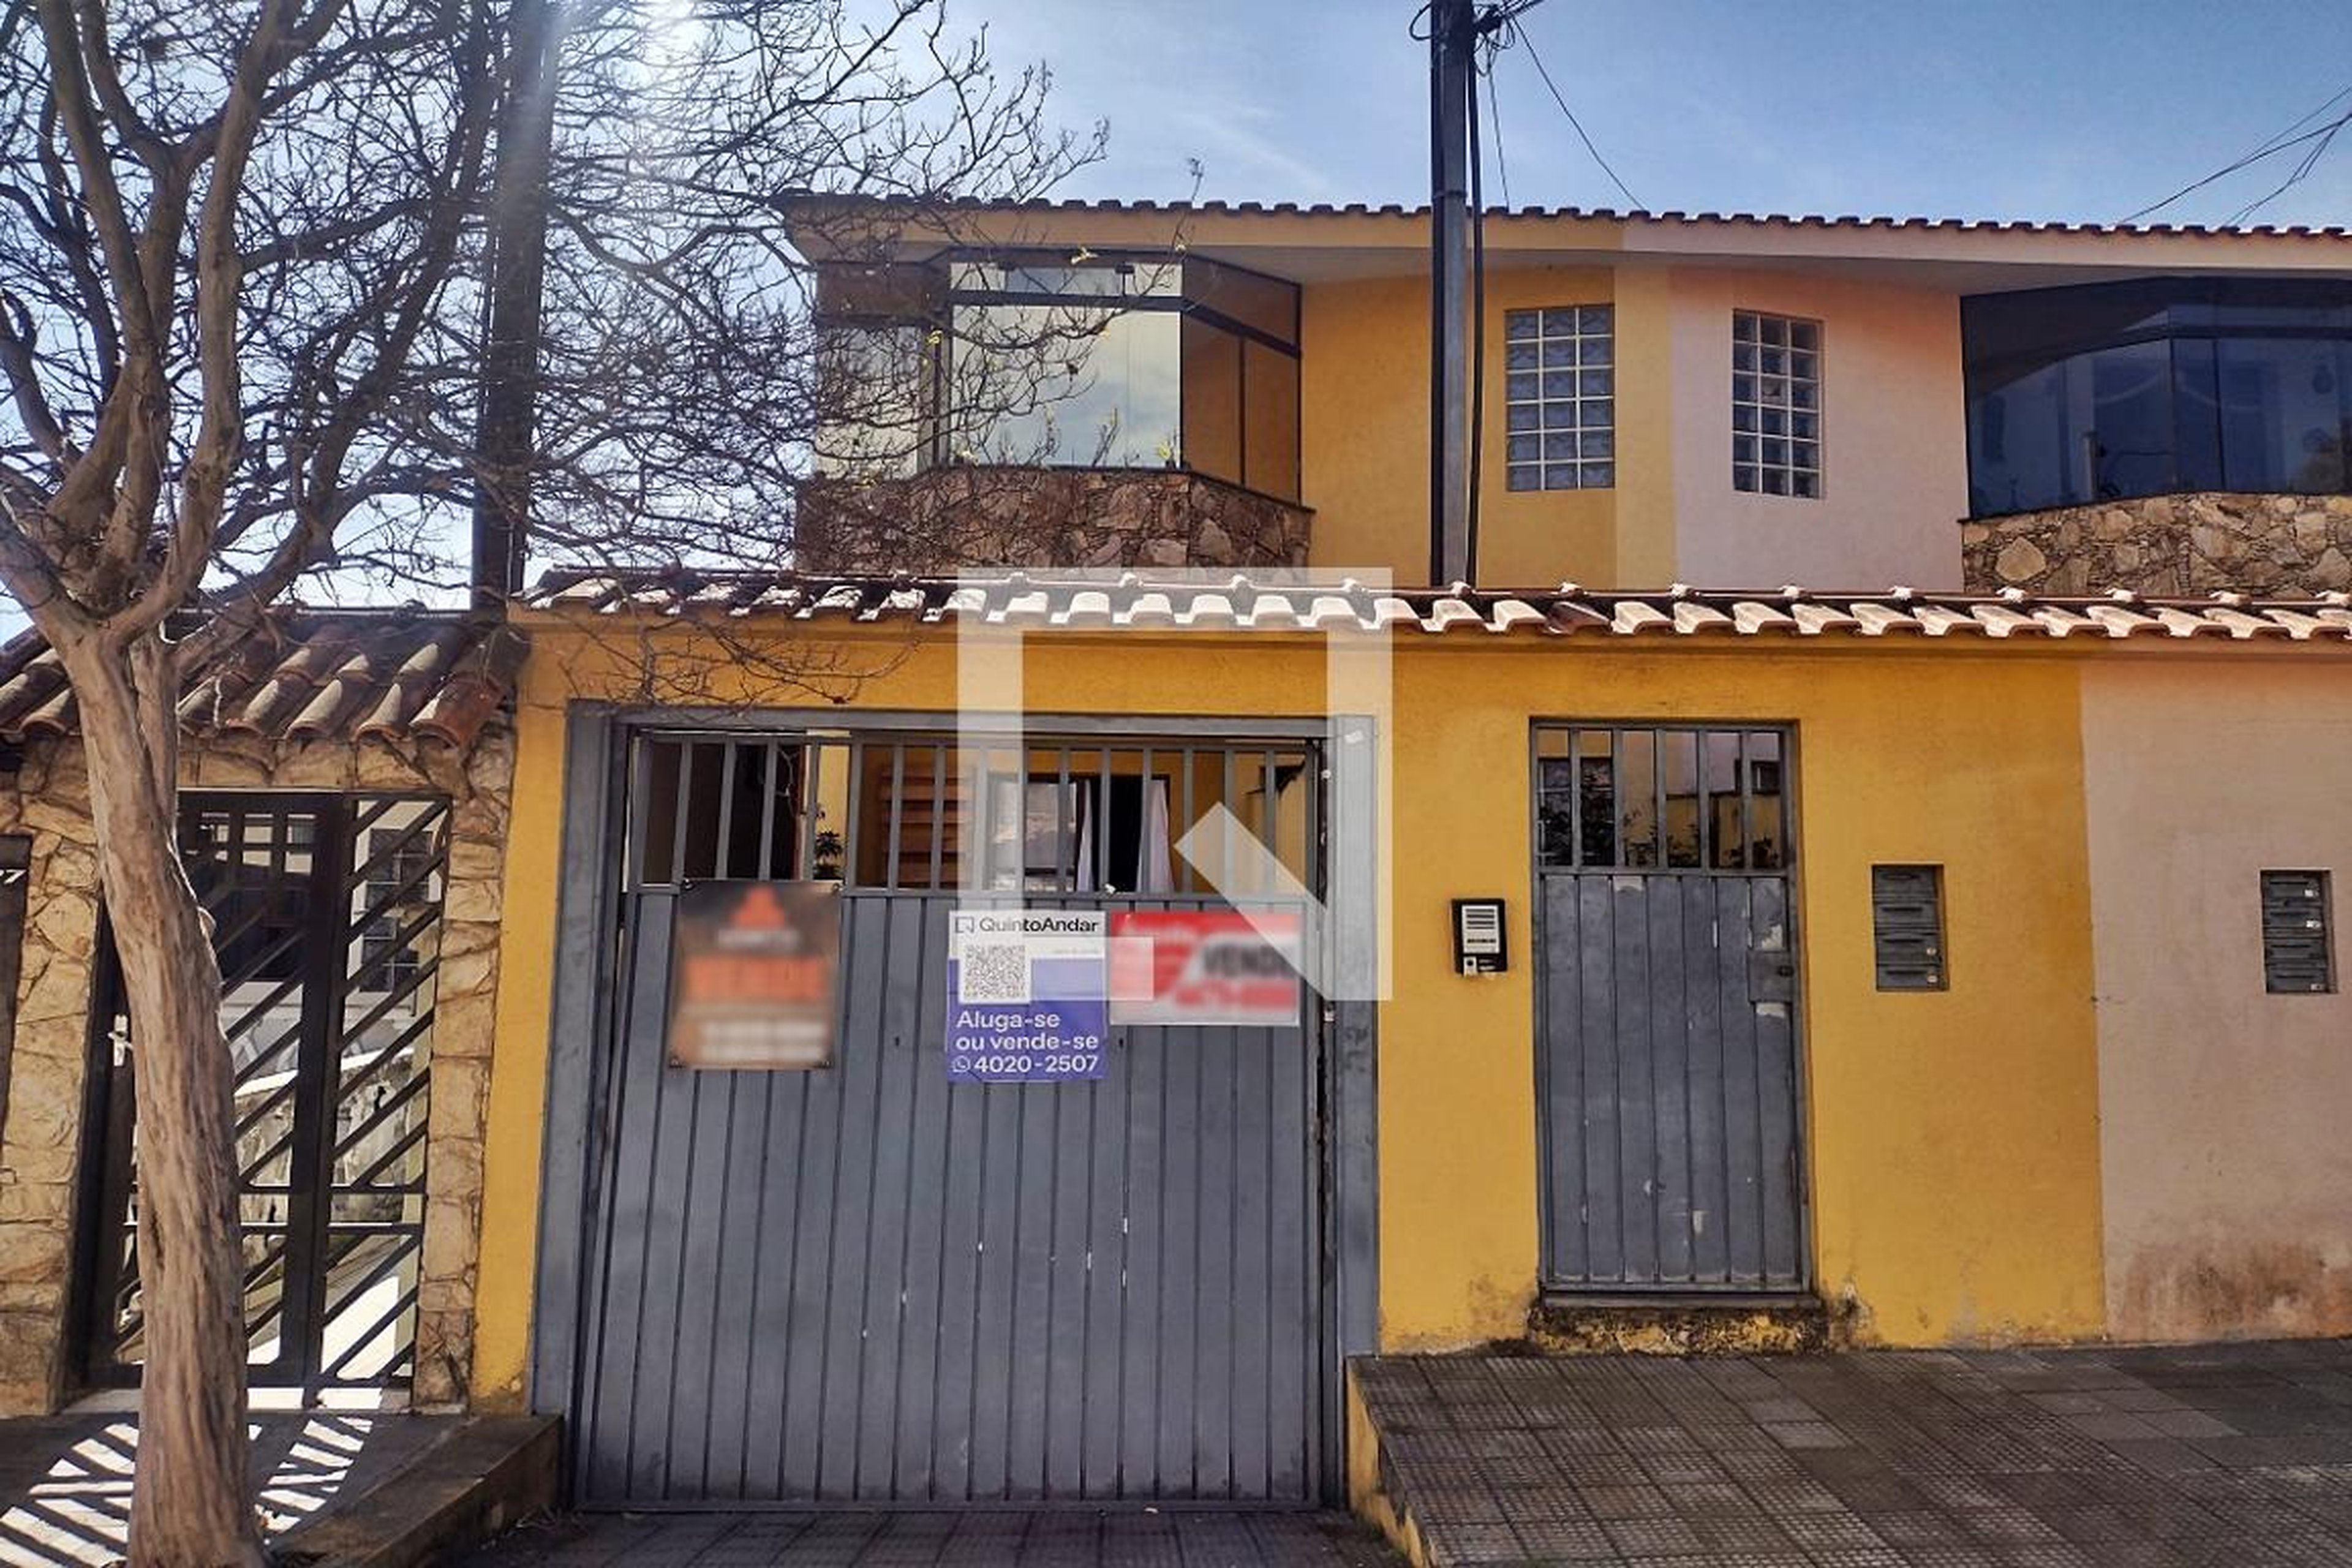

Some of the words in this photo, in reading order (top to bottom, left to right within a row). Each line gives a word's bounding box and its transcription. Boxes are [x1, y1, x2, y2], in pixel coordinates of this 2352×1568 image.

[979, 917, 1099, 932] QuintoAndar
[956, 1011, 1060, 1032] Aluga-se
[956, 1037, 984, 1050] ou
[990, 1033, 1098, 1050] vende-se
[974, 1055, 1098, 1072] 4020-2507
